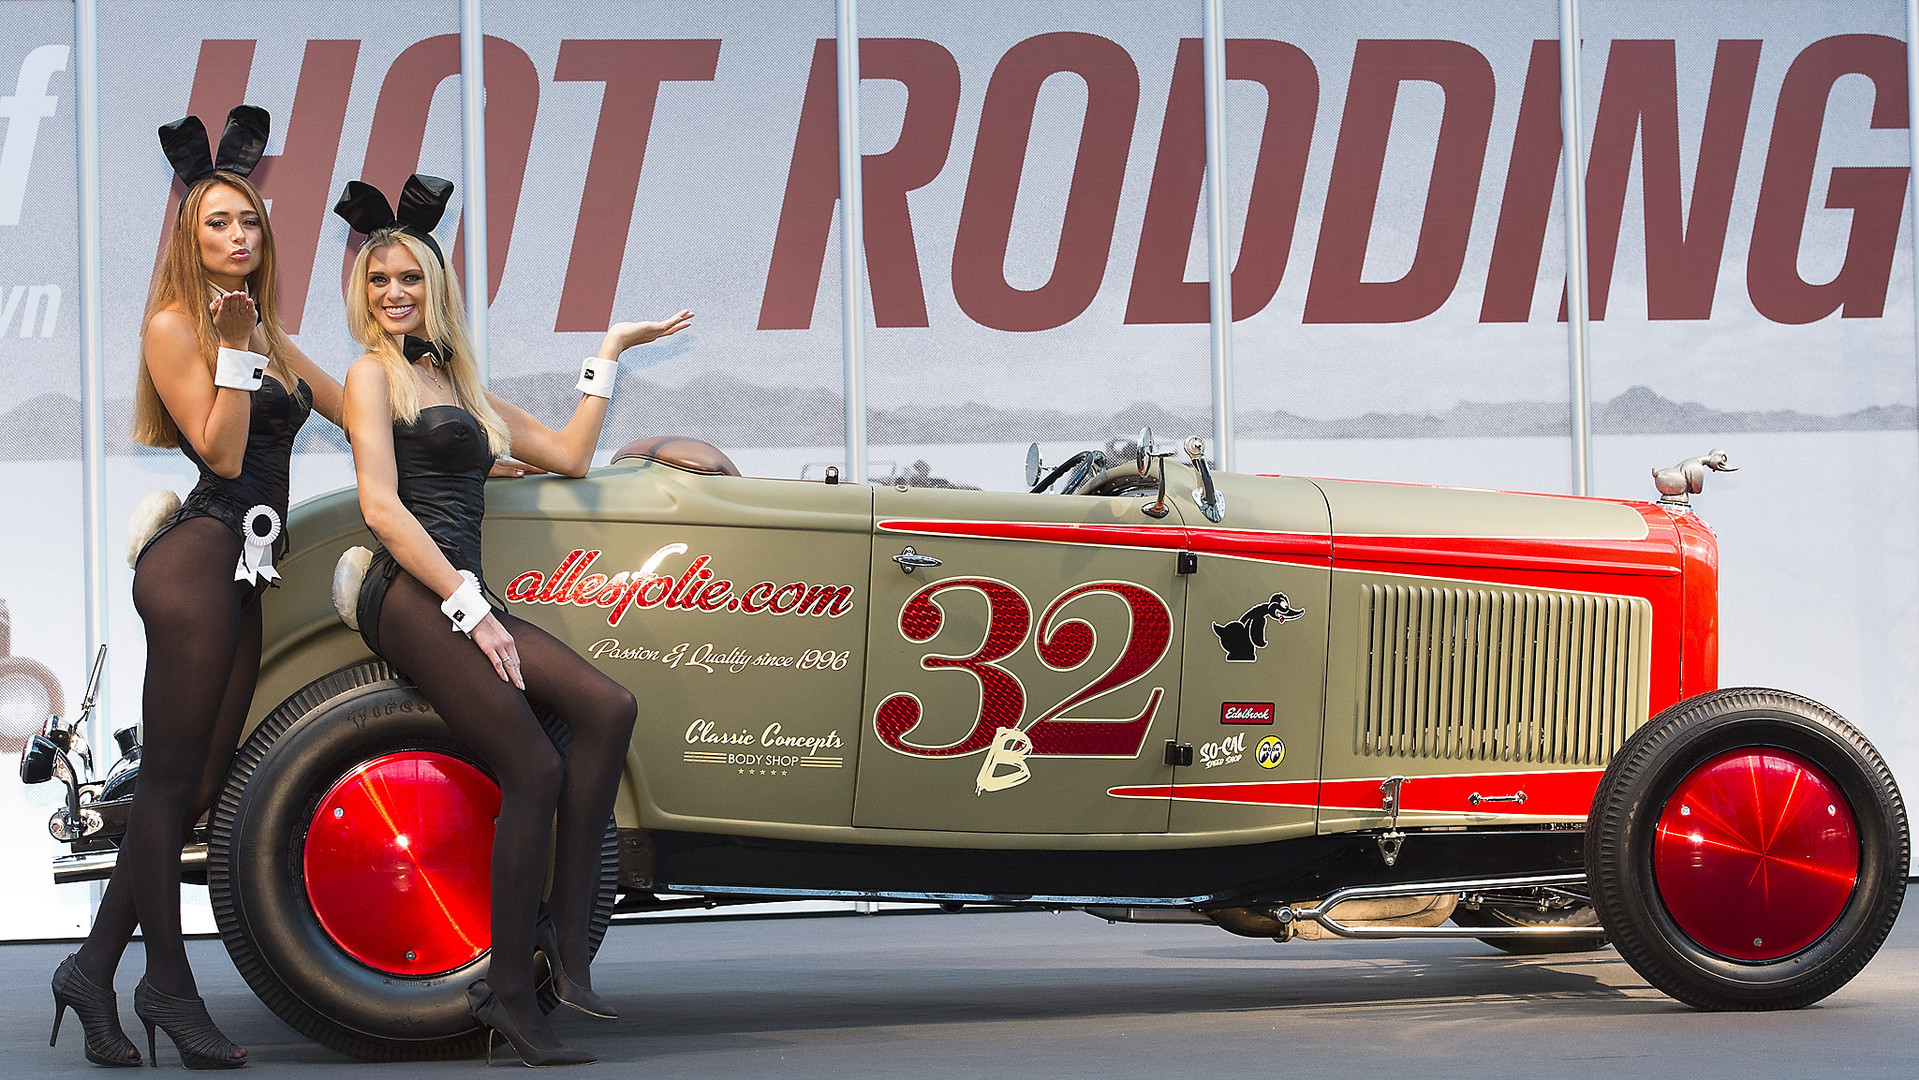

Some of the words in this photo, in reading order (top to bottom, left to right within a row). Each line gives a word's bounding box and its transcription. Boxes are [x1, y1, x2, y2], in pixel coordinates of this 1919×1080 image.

[140, 33, 722, 335] HOT
[757, 31, 1912, 333] RODDING
[505, 542, 854, 628] allesfolie.com
[588, 638, 660, 661] Passion
[662, 643, 690, 669] &
[685, 643, 752, 674] Quality
[751, 652, 794, 667] since
[795, 648, 850, 671] 1996
[873, 575, 1174, 759] 32
[1225, 707, 1270, 720] Edelbrock
[684, 718, 756, 745] Classic
[760, 722, 845, 756] Concepts
[1199, 732, 1247, 763] SO-CAL
[728, 753, 763, 766] BODY
[765, 755, 799, 767] SHOP
